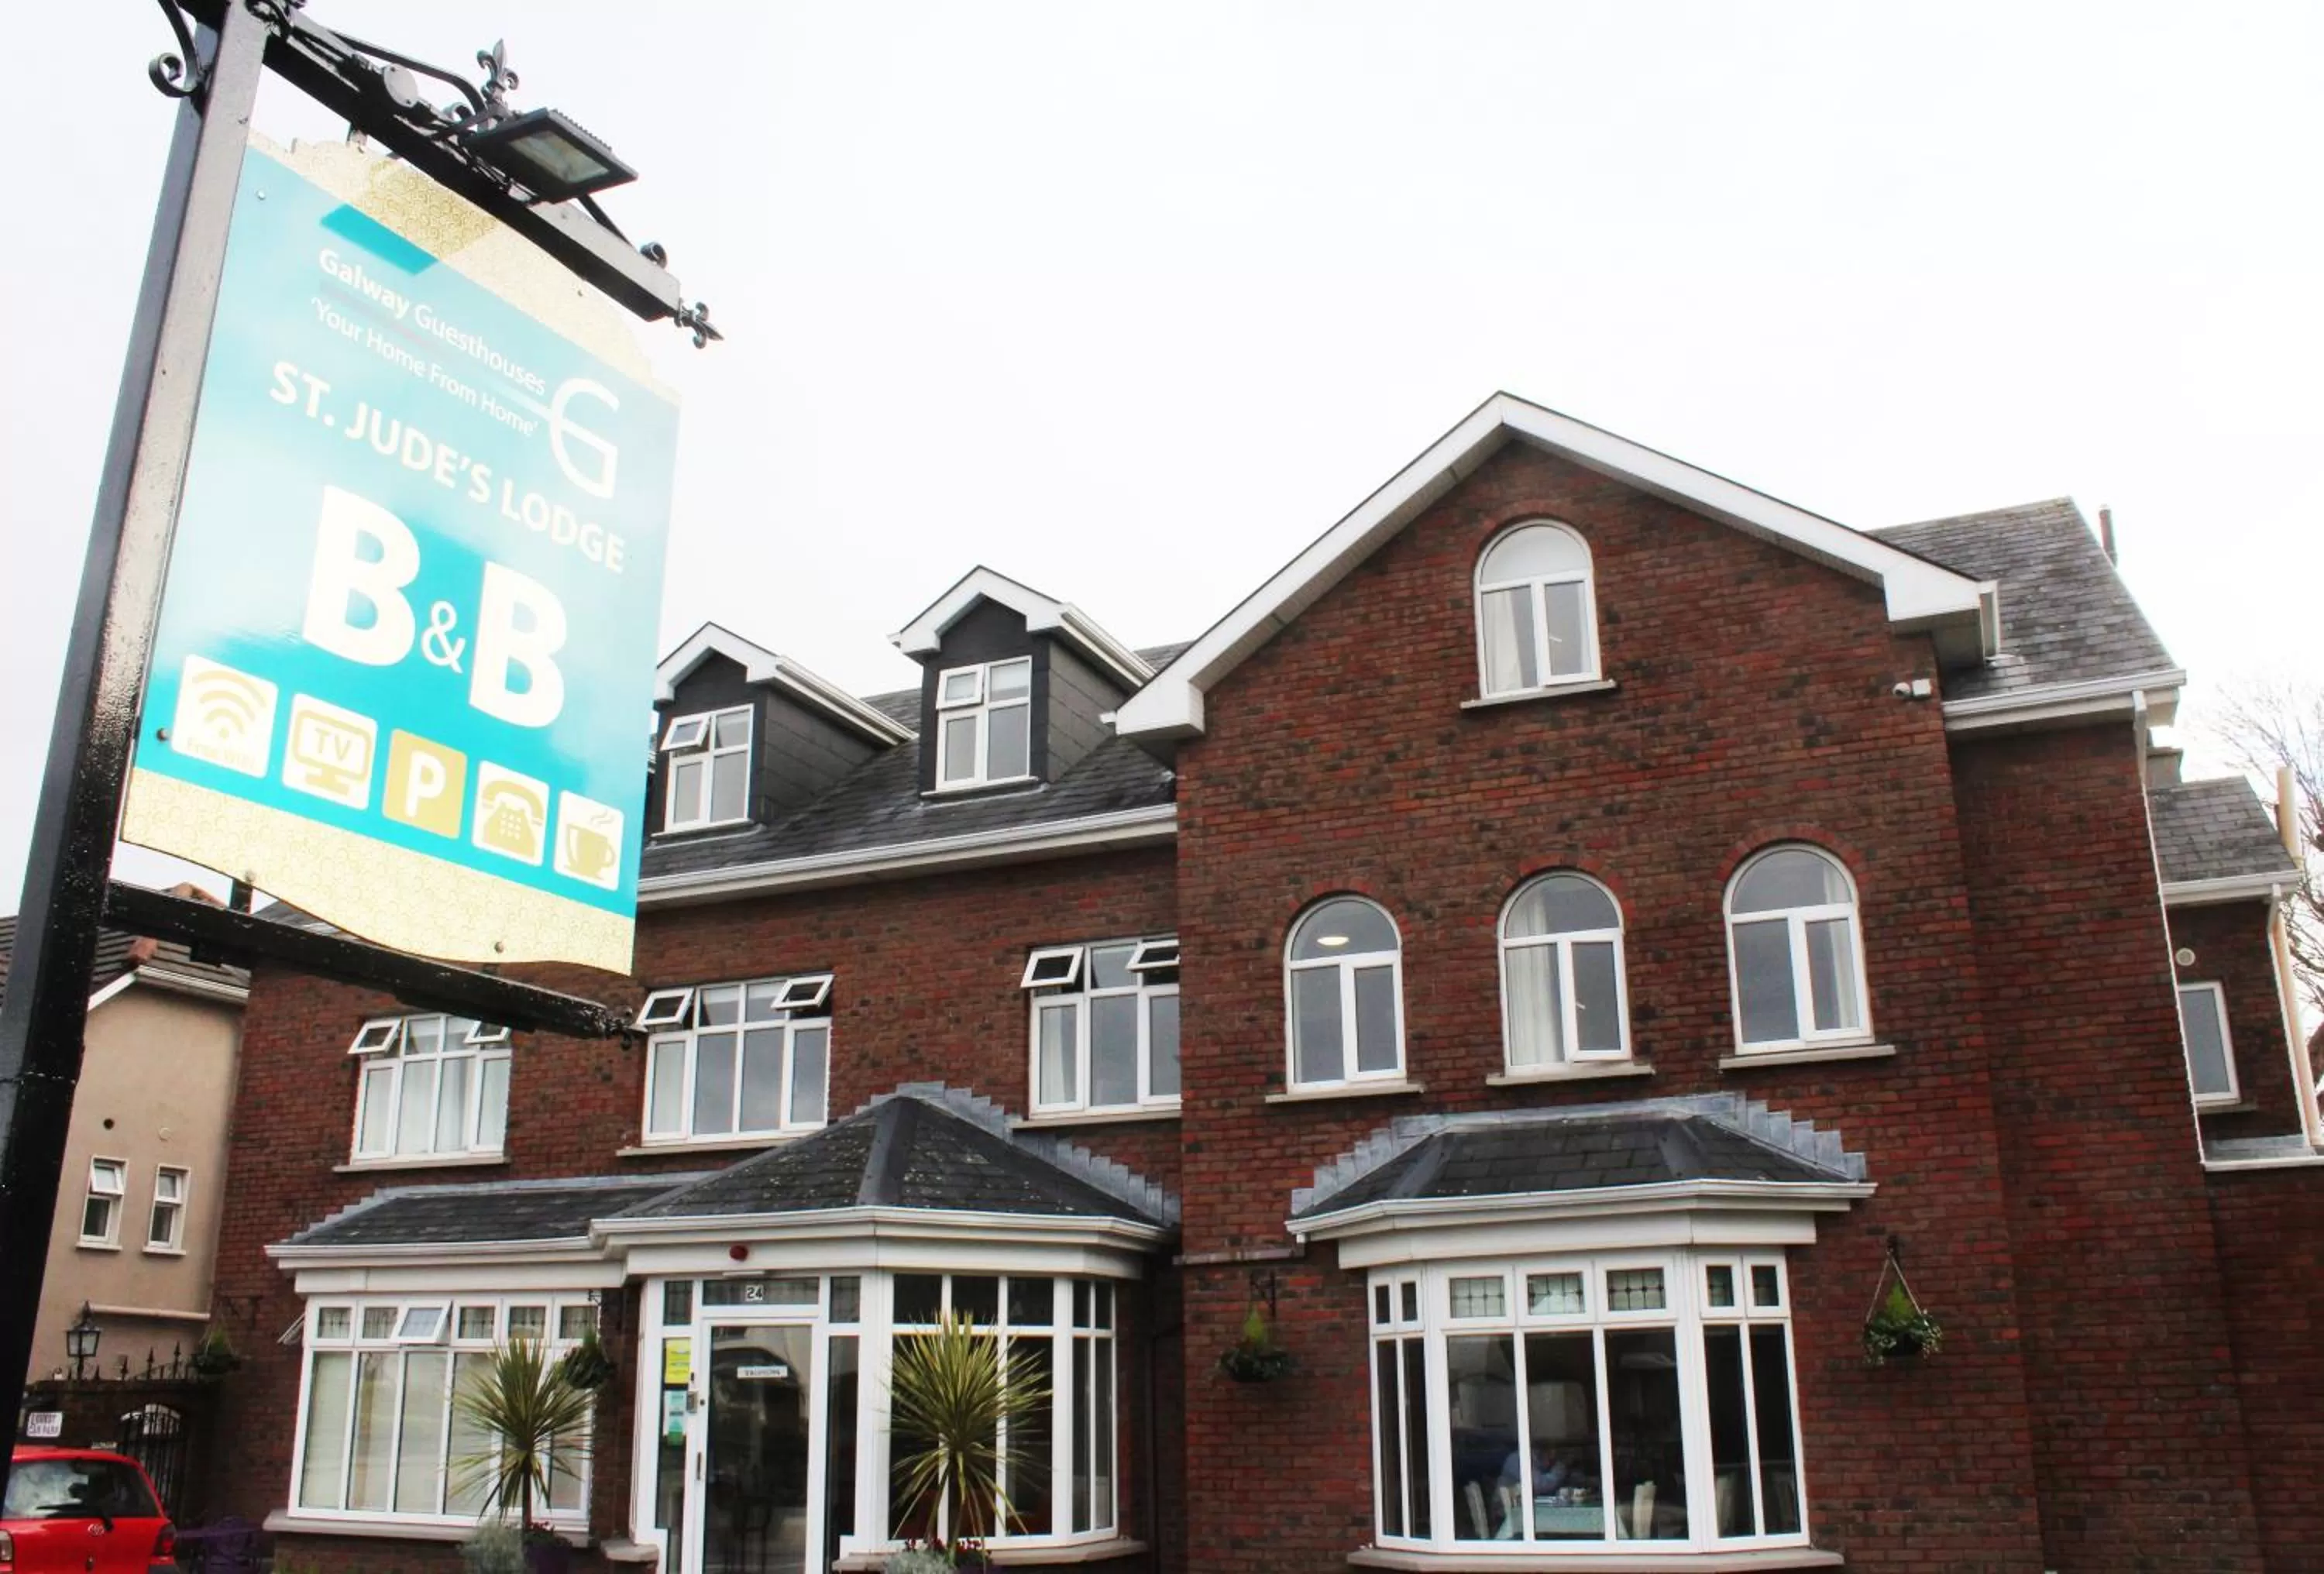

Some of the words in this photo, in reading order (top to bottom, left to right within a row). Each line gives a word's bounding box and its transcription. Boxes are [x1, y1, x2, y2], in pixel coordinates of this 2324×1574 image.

[318, 247, 411, 319] Galway
[414, 304, 547, 397] Guesthouses
[366, 328, 427, 378] Home
[430, 363, 478, 407] From
[269, 359, 335, 427] ST.
[500, 477, 625, 574] LODGE
[314, 727, 354, 762] TV
[405, 751, 447, 818] P
[746, 1287, 763, 1299] 24
